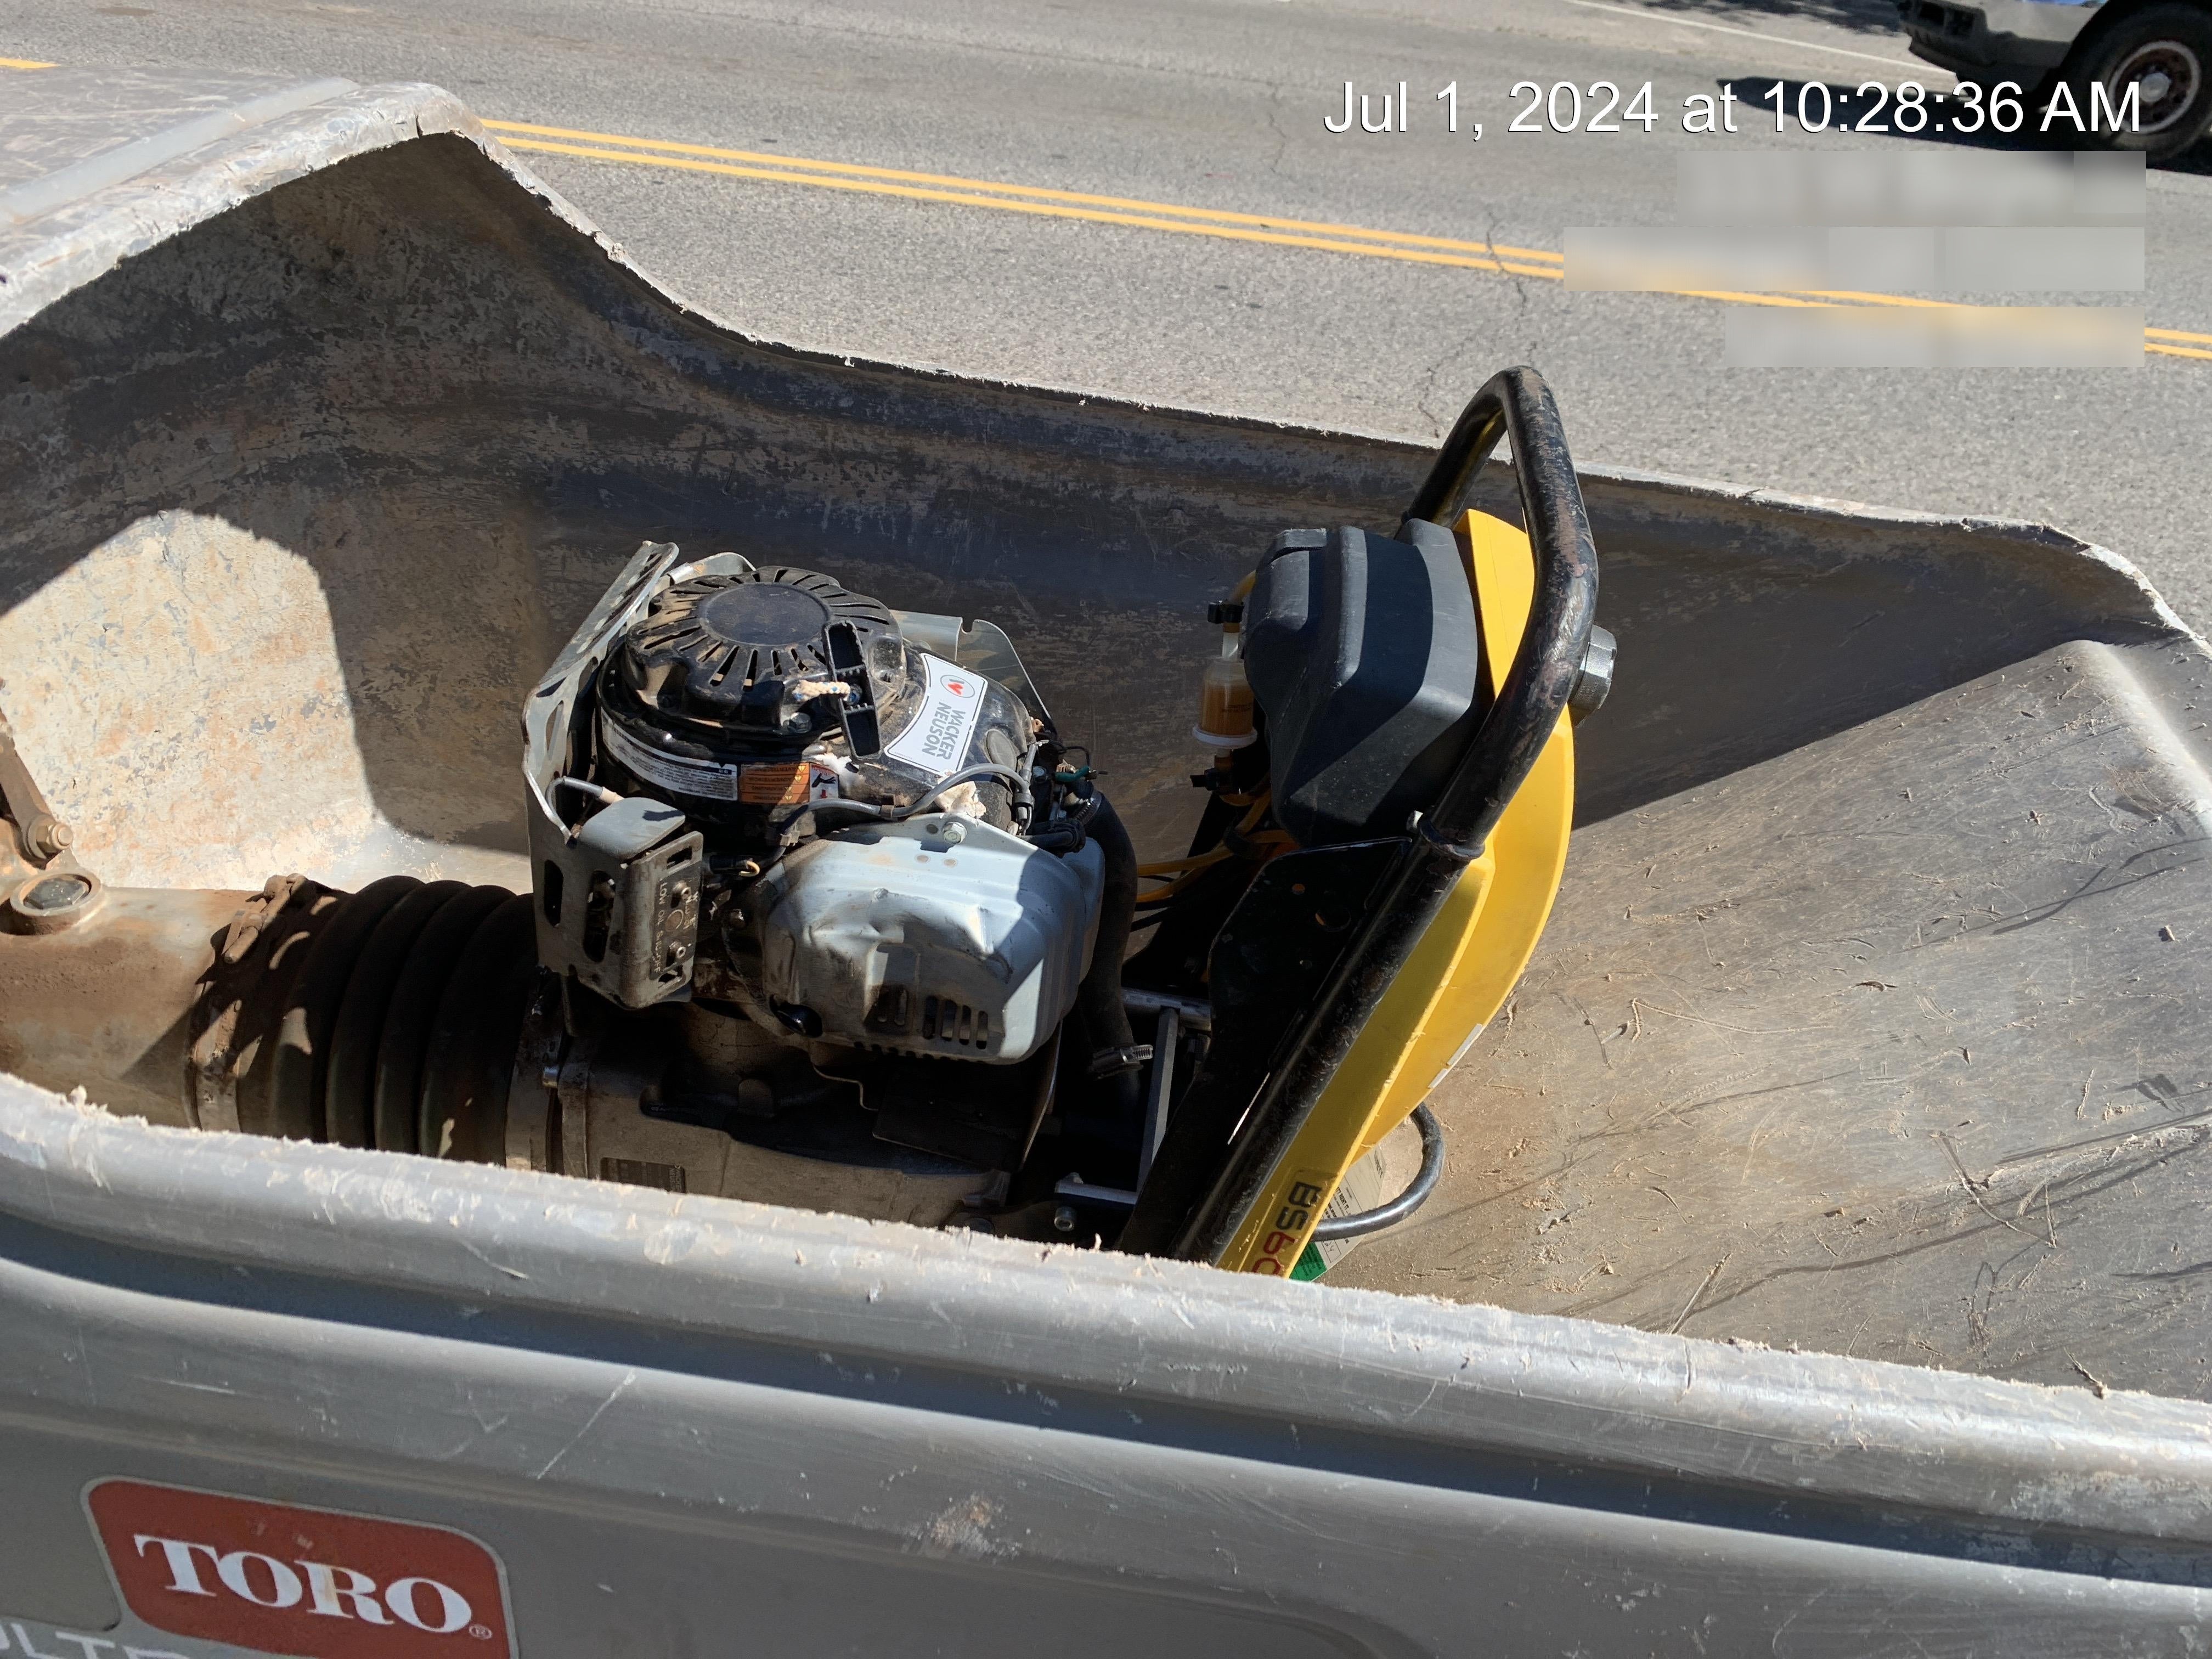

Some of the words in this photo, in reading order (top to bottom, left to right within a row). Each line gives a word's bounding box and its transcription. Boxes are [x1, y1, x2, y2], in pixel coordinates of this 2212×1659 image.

[922, 702, 952, 757] NEUSON
[936, 710, 966, 760] WACKER
[659, 882, 667, 905] LOW
[1339, 1193, 1347, 1205] RENT
[134, 1534, 472, 1633] TORO
